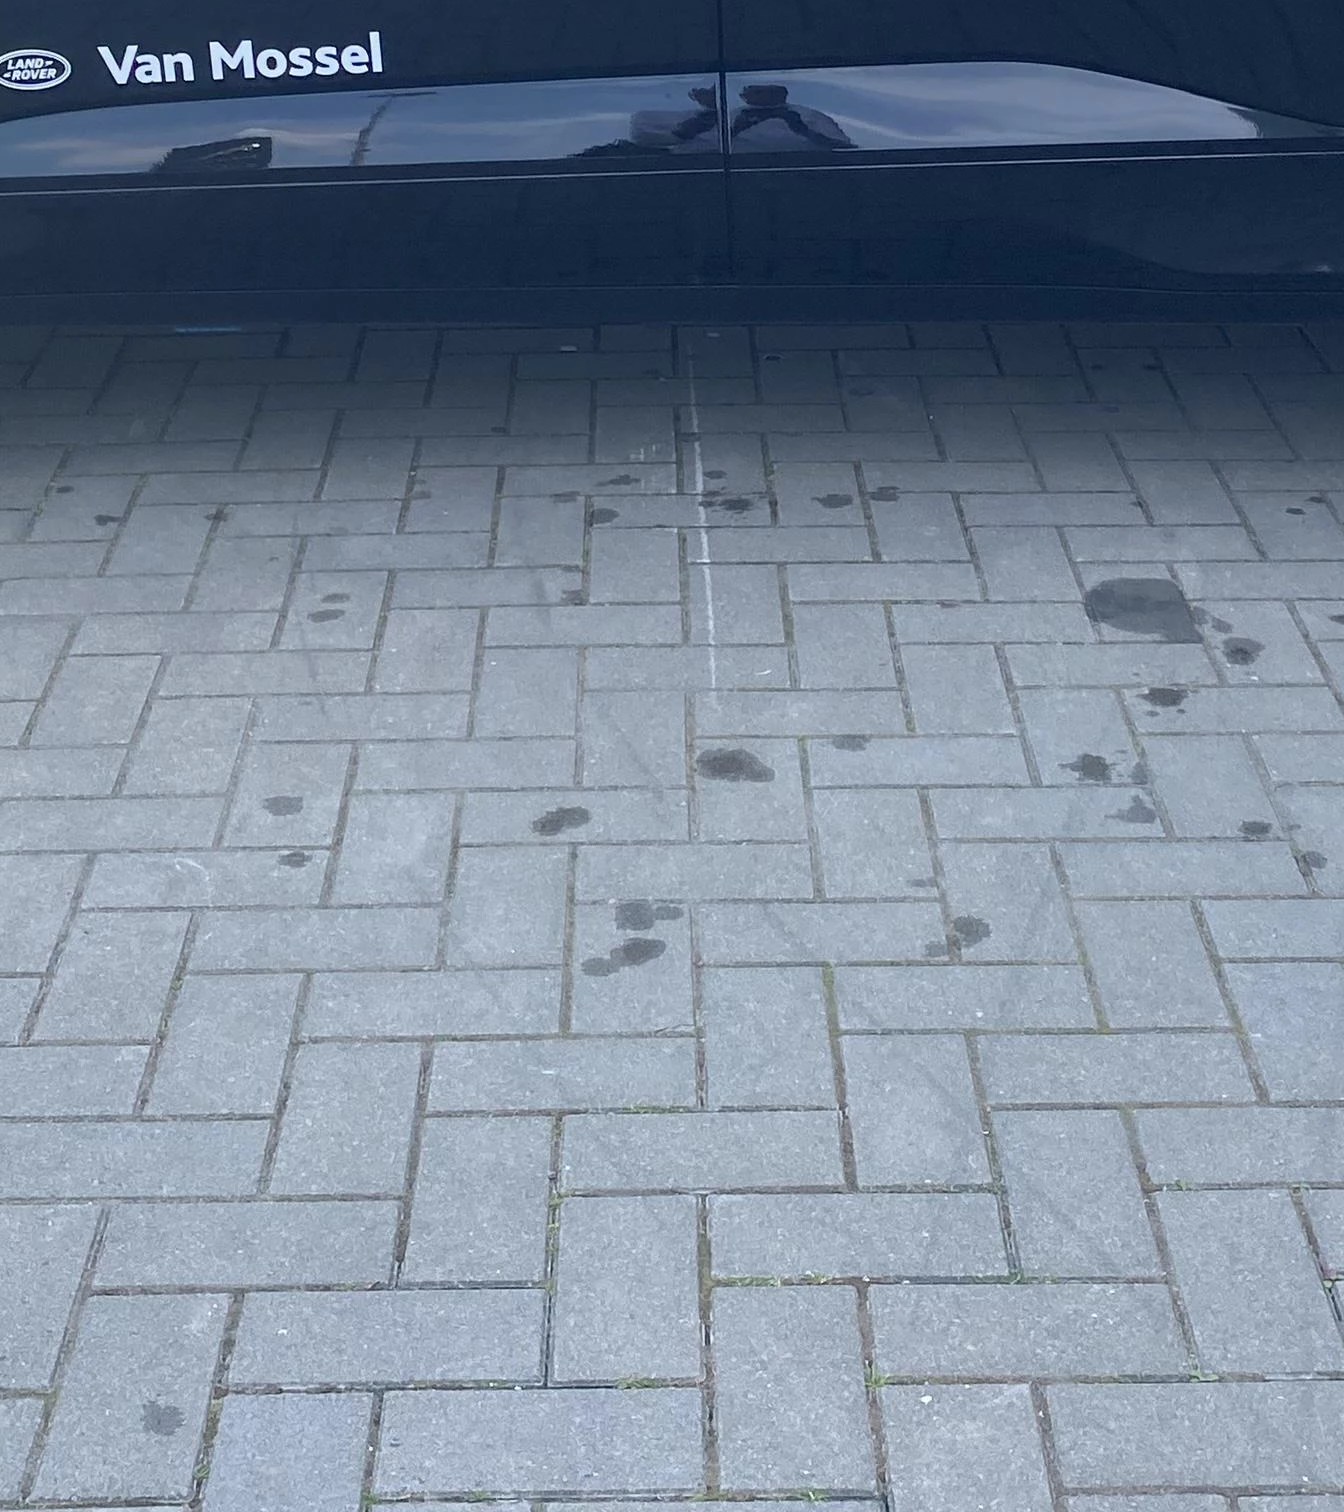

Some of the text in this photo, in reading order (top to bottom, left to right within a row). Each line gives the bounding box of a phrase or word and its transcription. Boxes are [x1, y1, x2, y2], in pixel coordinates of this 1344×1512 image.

[6, 58, 45, 71] LAND
[97, 31, 384, 85] Van Mossel
[10, 68, 57, 81] ROVER
